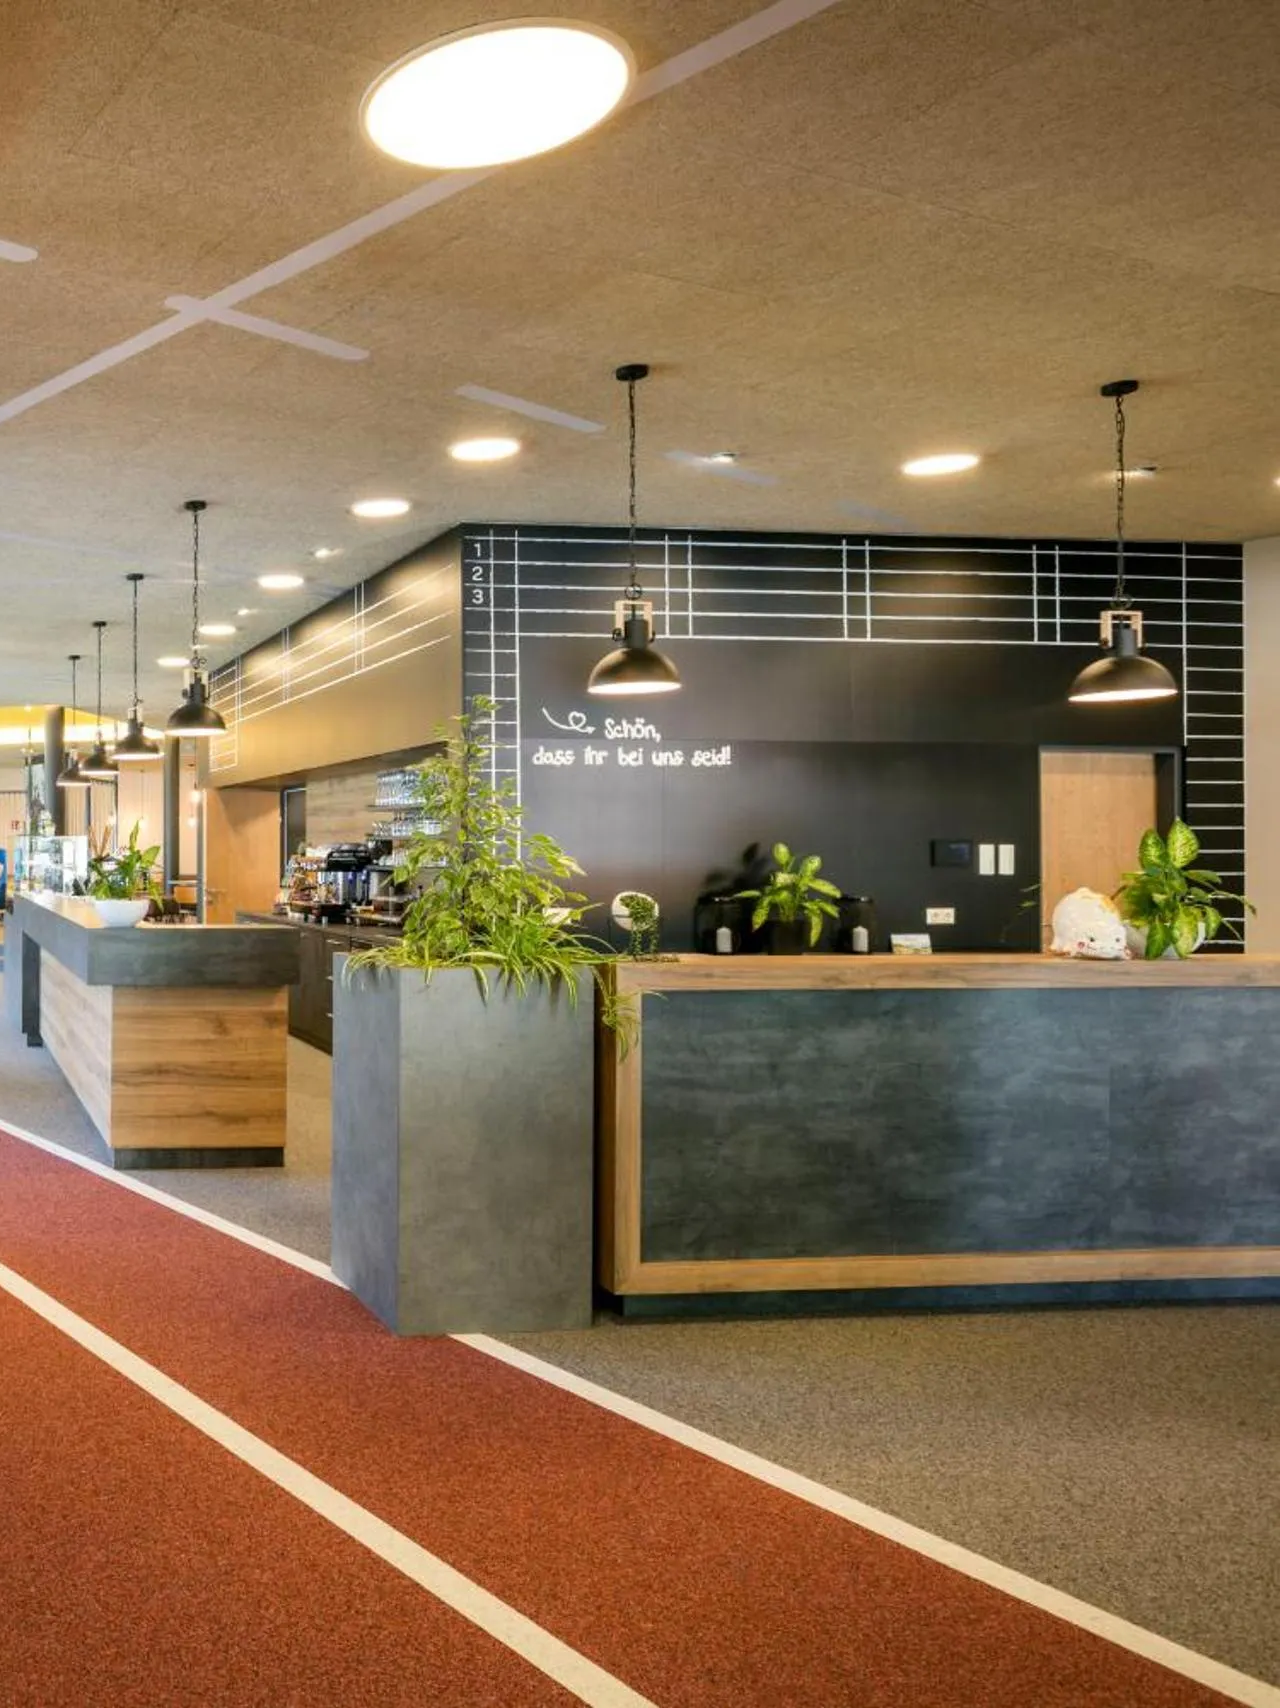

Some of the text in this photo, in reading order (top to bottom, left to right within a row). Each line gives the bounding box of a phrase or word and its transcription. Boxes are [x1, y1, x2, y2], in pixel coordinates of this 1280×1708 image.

[473, 543, 482, 558] 1
[471, 566, 484, 582] 2
[471, 589, 485, 604] 3
[604, 717, 662, 743] Schön,
[531, 745, 576, 766] dass
[617, 746, 644, 767] bei
[651, 751, 685, 767] uns
[690, 745, 733, 767] seid!
